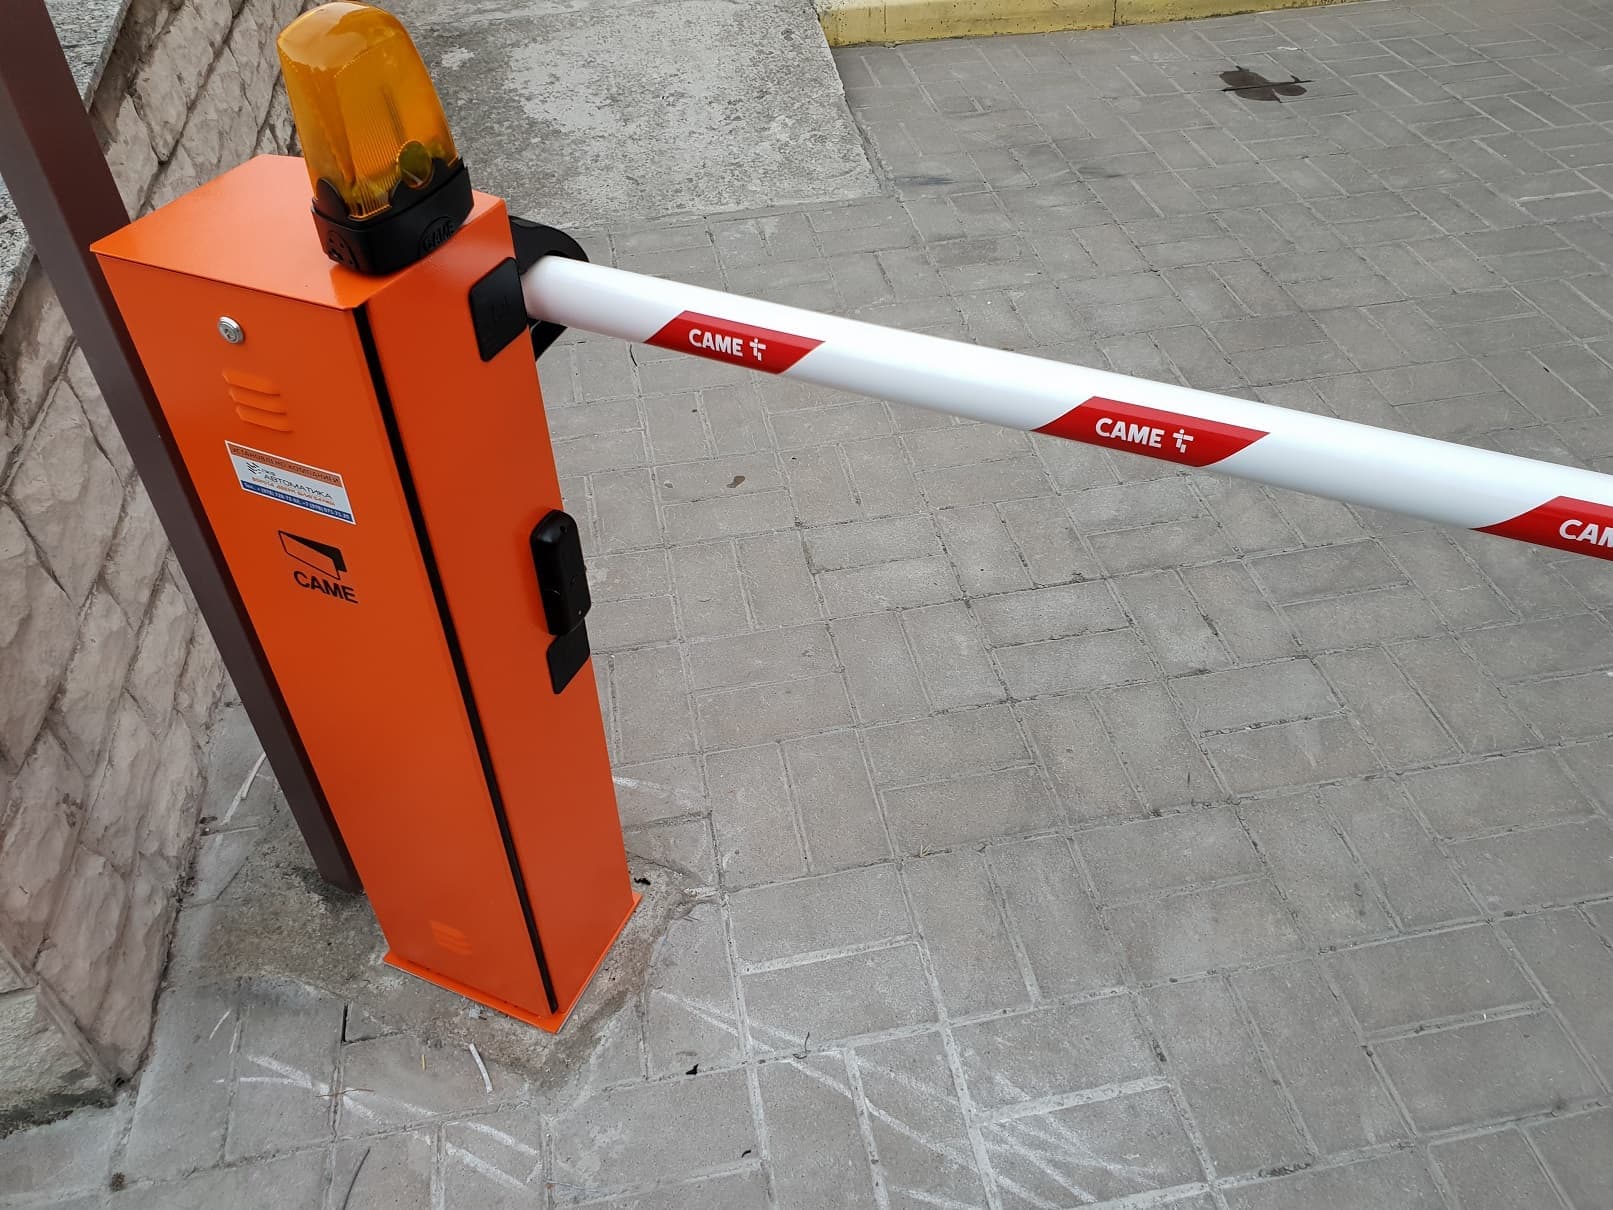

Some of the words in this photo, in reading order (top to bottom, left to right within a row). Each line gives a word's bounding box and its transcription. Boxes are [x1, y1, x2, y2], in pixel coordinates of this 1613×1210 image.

[688, 328, 744, 357] CAME
[1095, 417, 1165, 449] CAME
[264, 475, 333, 499] АВТОМАТИКА
[293, 570, 359, 604] CAME
